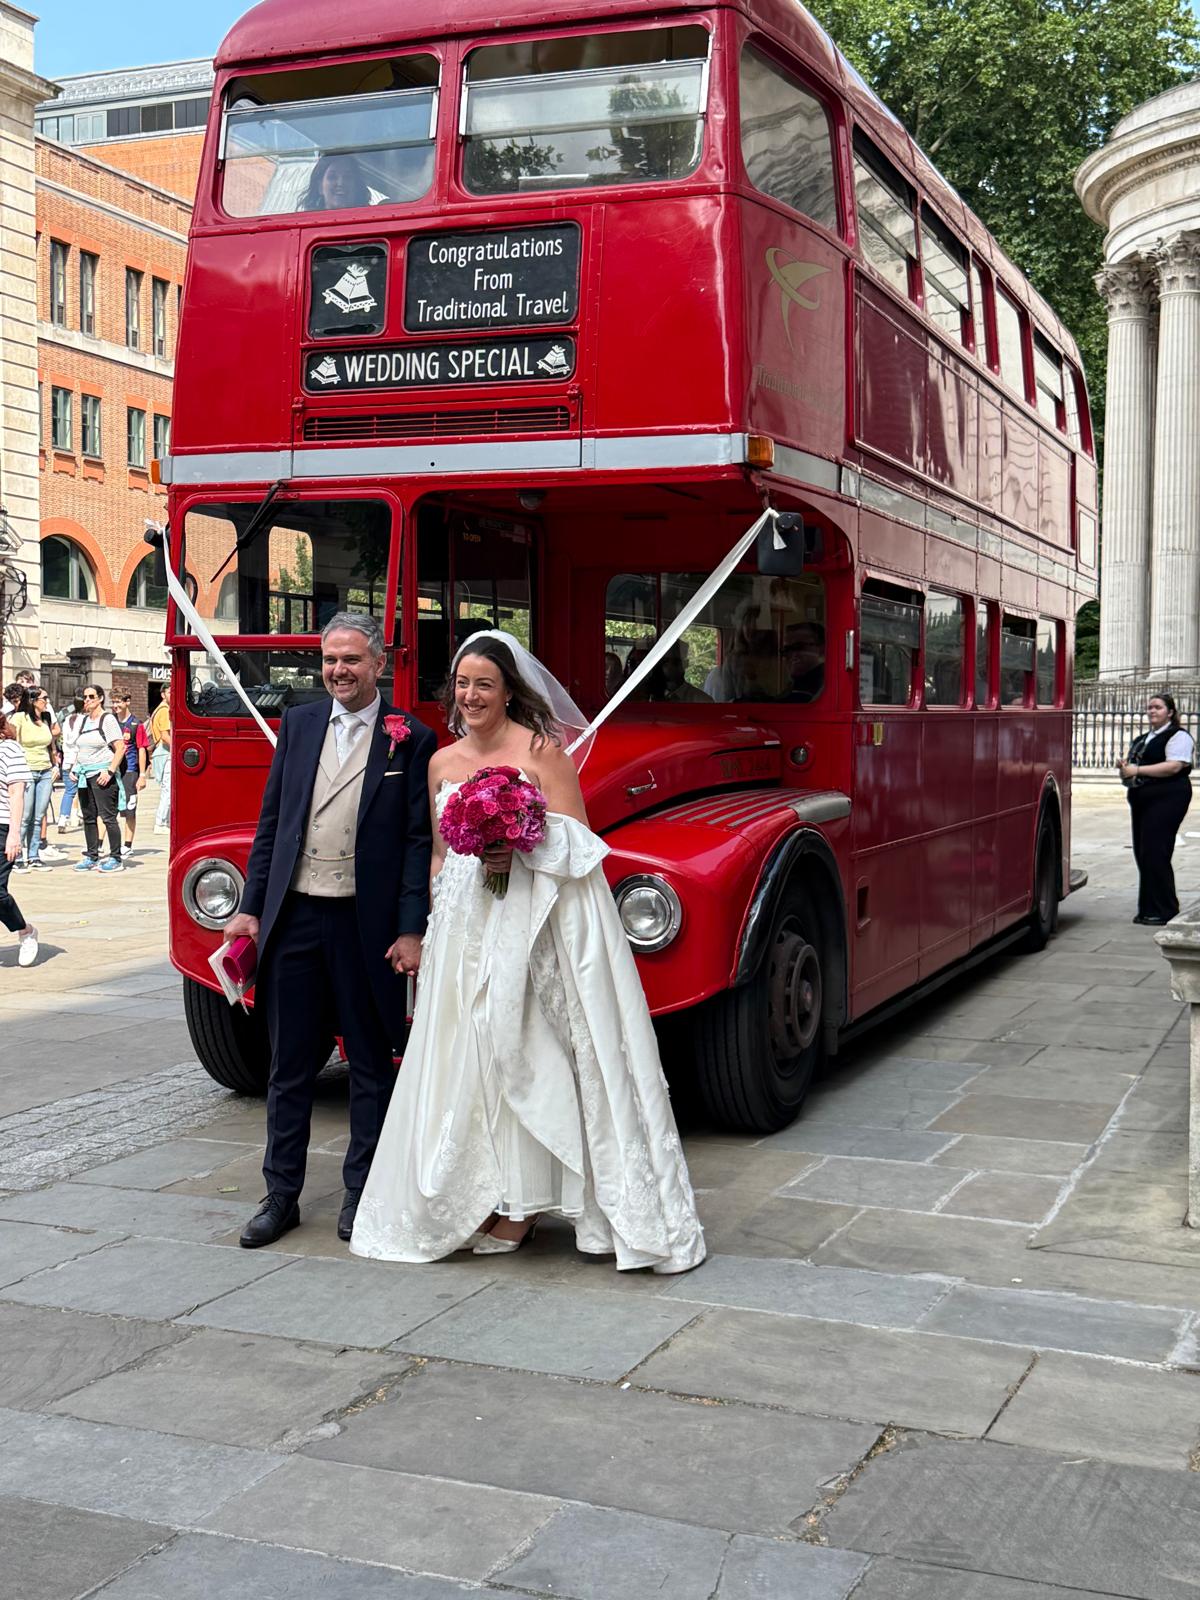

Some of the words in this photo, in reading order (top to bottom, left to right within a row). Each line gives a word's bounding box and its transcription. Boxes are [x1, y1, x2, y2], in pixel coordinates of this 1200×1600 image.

[429, 237, 562, 267] Congratulations
[474, 269, 512, 291] From
[418, 298, 507, 322] Traditional
[517, 292, 568, 316] Travel
[345, 353, 439, 382] WEDDING
[448, 348, 534, 378] SPECIAL
